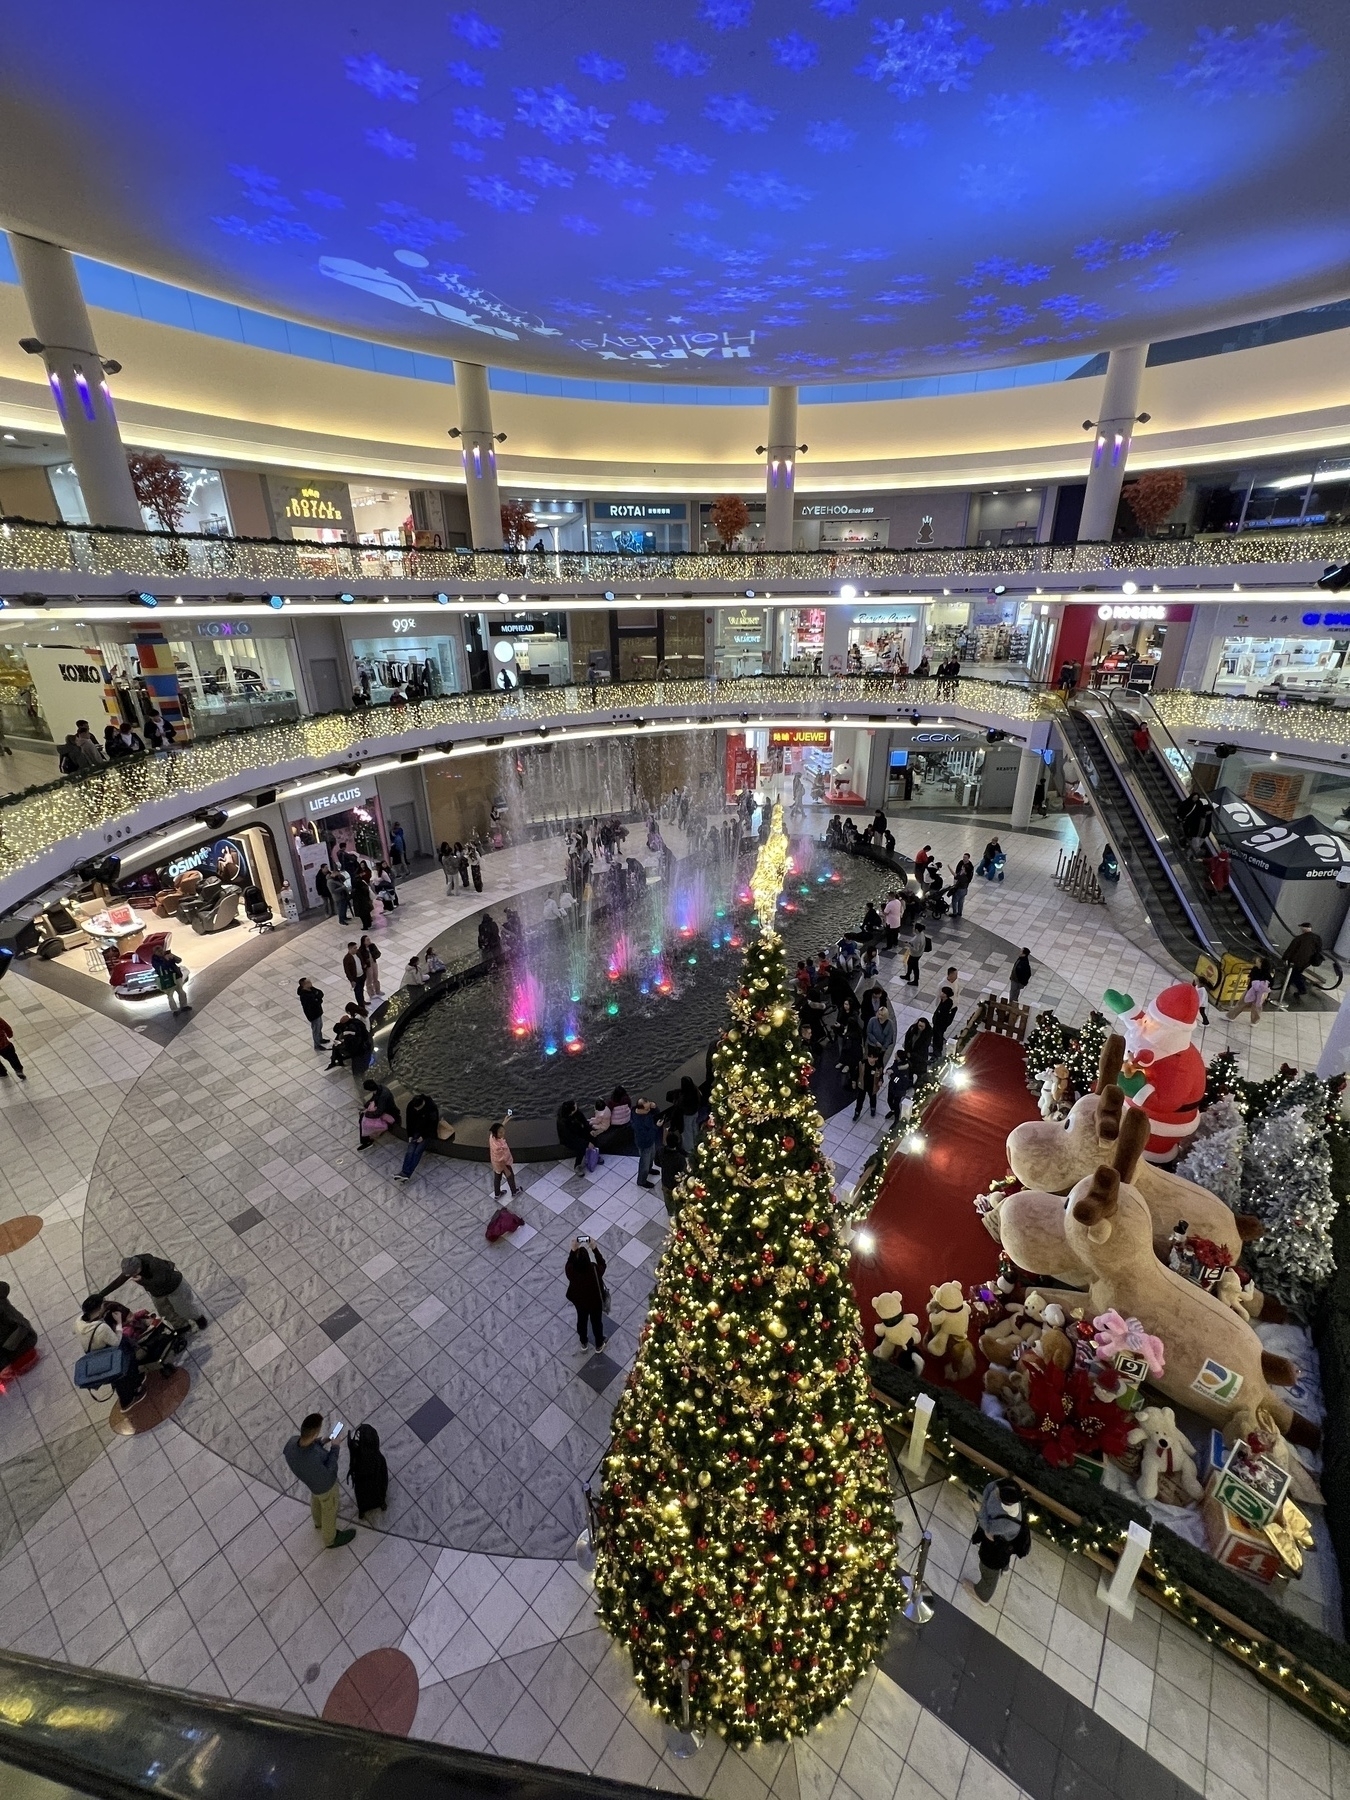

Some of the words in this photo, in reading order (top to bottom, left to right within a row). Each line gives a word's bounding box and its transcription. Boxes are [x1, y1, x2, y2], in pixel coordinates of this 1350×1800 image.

[570, 329, 756, 351] Holidays!
[596, 345, 751, 360] HAPPY
[291, 498, 335, 511] ROYAL
[609, 505, 646, 517] ROTAI
[285, 506, 342, 520] JUBILEE
[500, 624, 535, 633] MOPHEAD
[793, 732, 827, 742] JUEWEI
[309, 796, 331, 812] LIFE
[330, 793, 338, 805] 4
[337, 787, 362, 803] CUTS
[1248, 855, 1270, 870] centre
